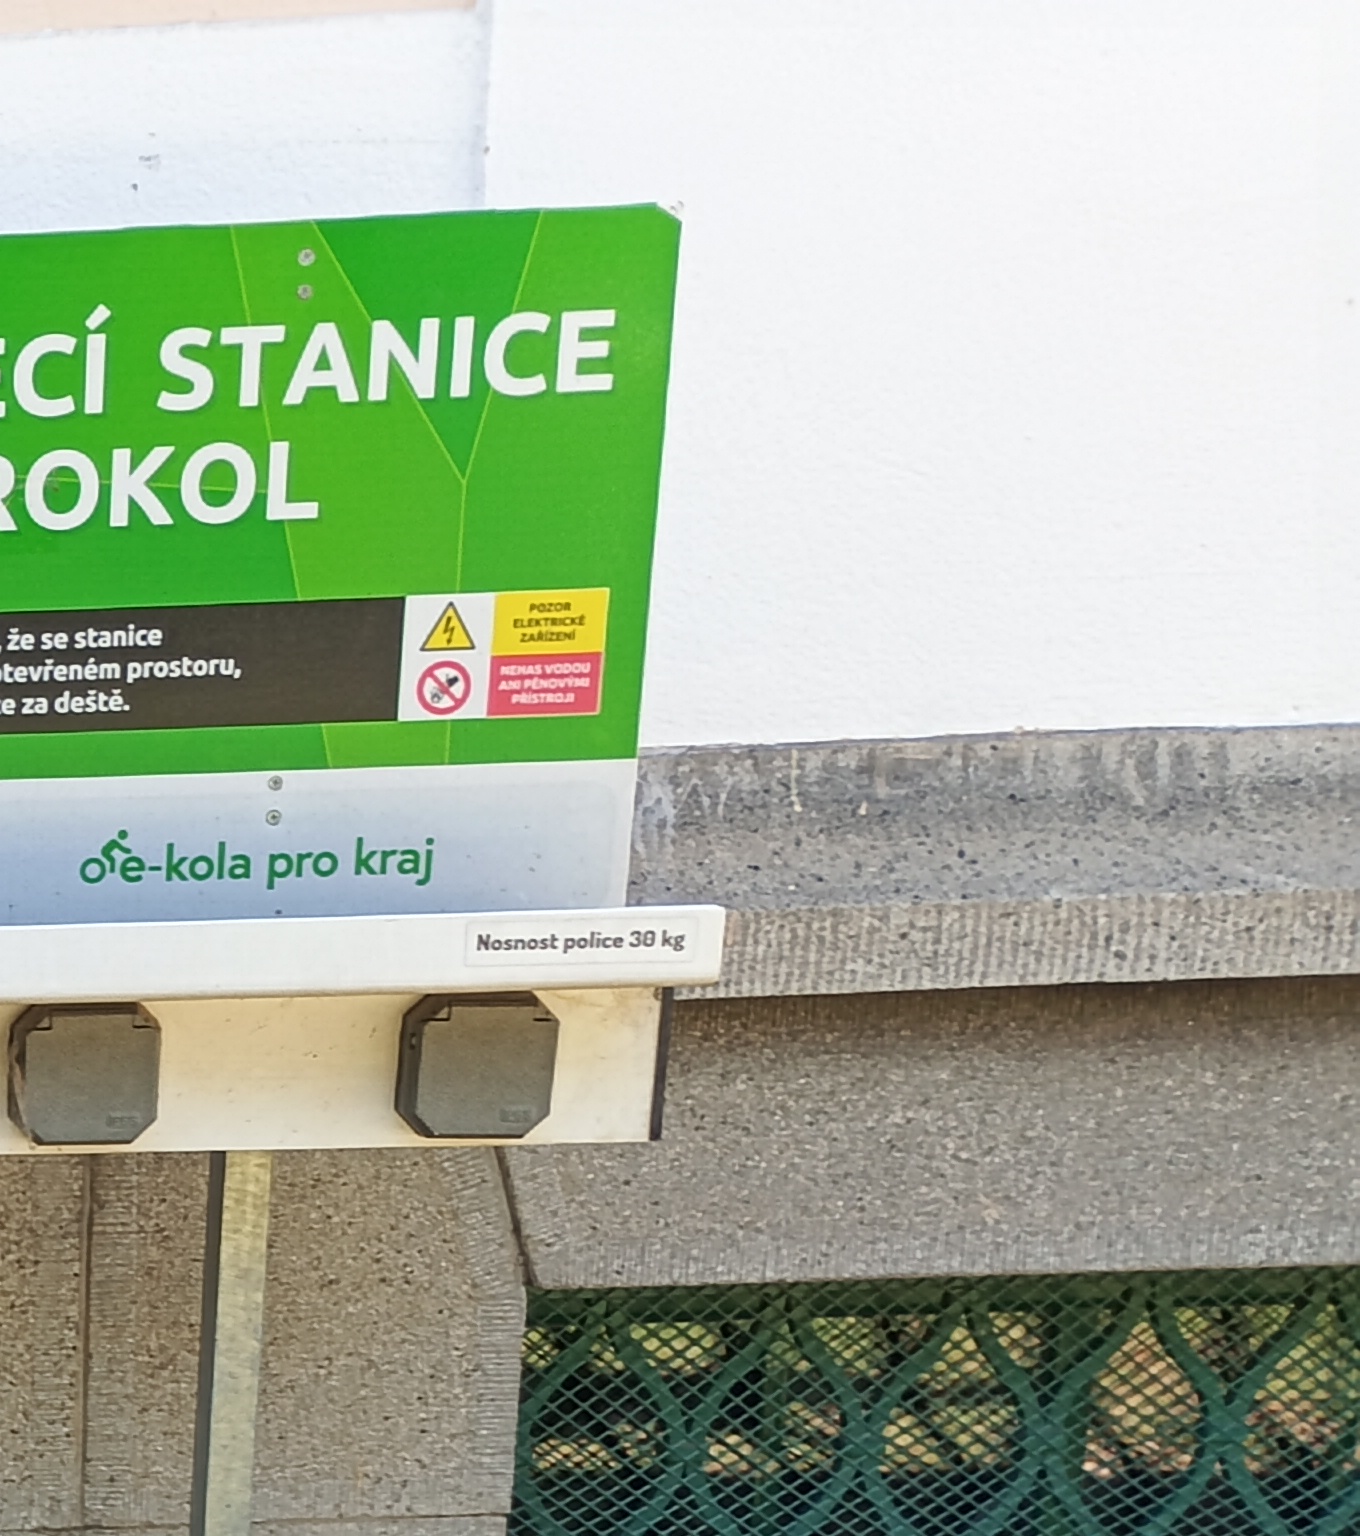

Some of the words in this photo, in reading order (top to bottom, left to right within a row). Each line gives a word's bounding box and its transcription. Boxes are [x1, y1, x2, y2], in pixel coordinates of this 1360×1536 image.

[157, 309, 617, 412] STANICE
[529, 602, 572, 613] POZOR
[513, 614, 585, 629] ELEKTRICKÉ
[7, 627, 36, 652] že
[40, 631, 69, 652] se
[74, 625, 163, 649] stanice
[520, 629, 576, 643] ZAŘÍZENÍ
[126, 656, 242, 685] prostoru,
[544, 662, 591, 675] VODOU
[22, 696, 49, 716] za
[54, 690, 130, 715] deště.
[120, 841, 252, 885] e-kola
[265, 848, 339, 891] pro
[353, 837, 435, 886] kraj
[476, 933, 560, 952] Nosnost
[563, 931, 625, 954] police
[629, 931, 657, 949] 30
[661, 929, 686, 952] kg
